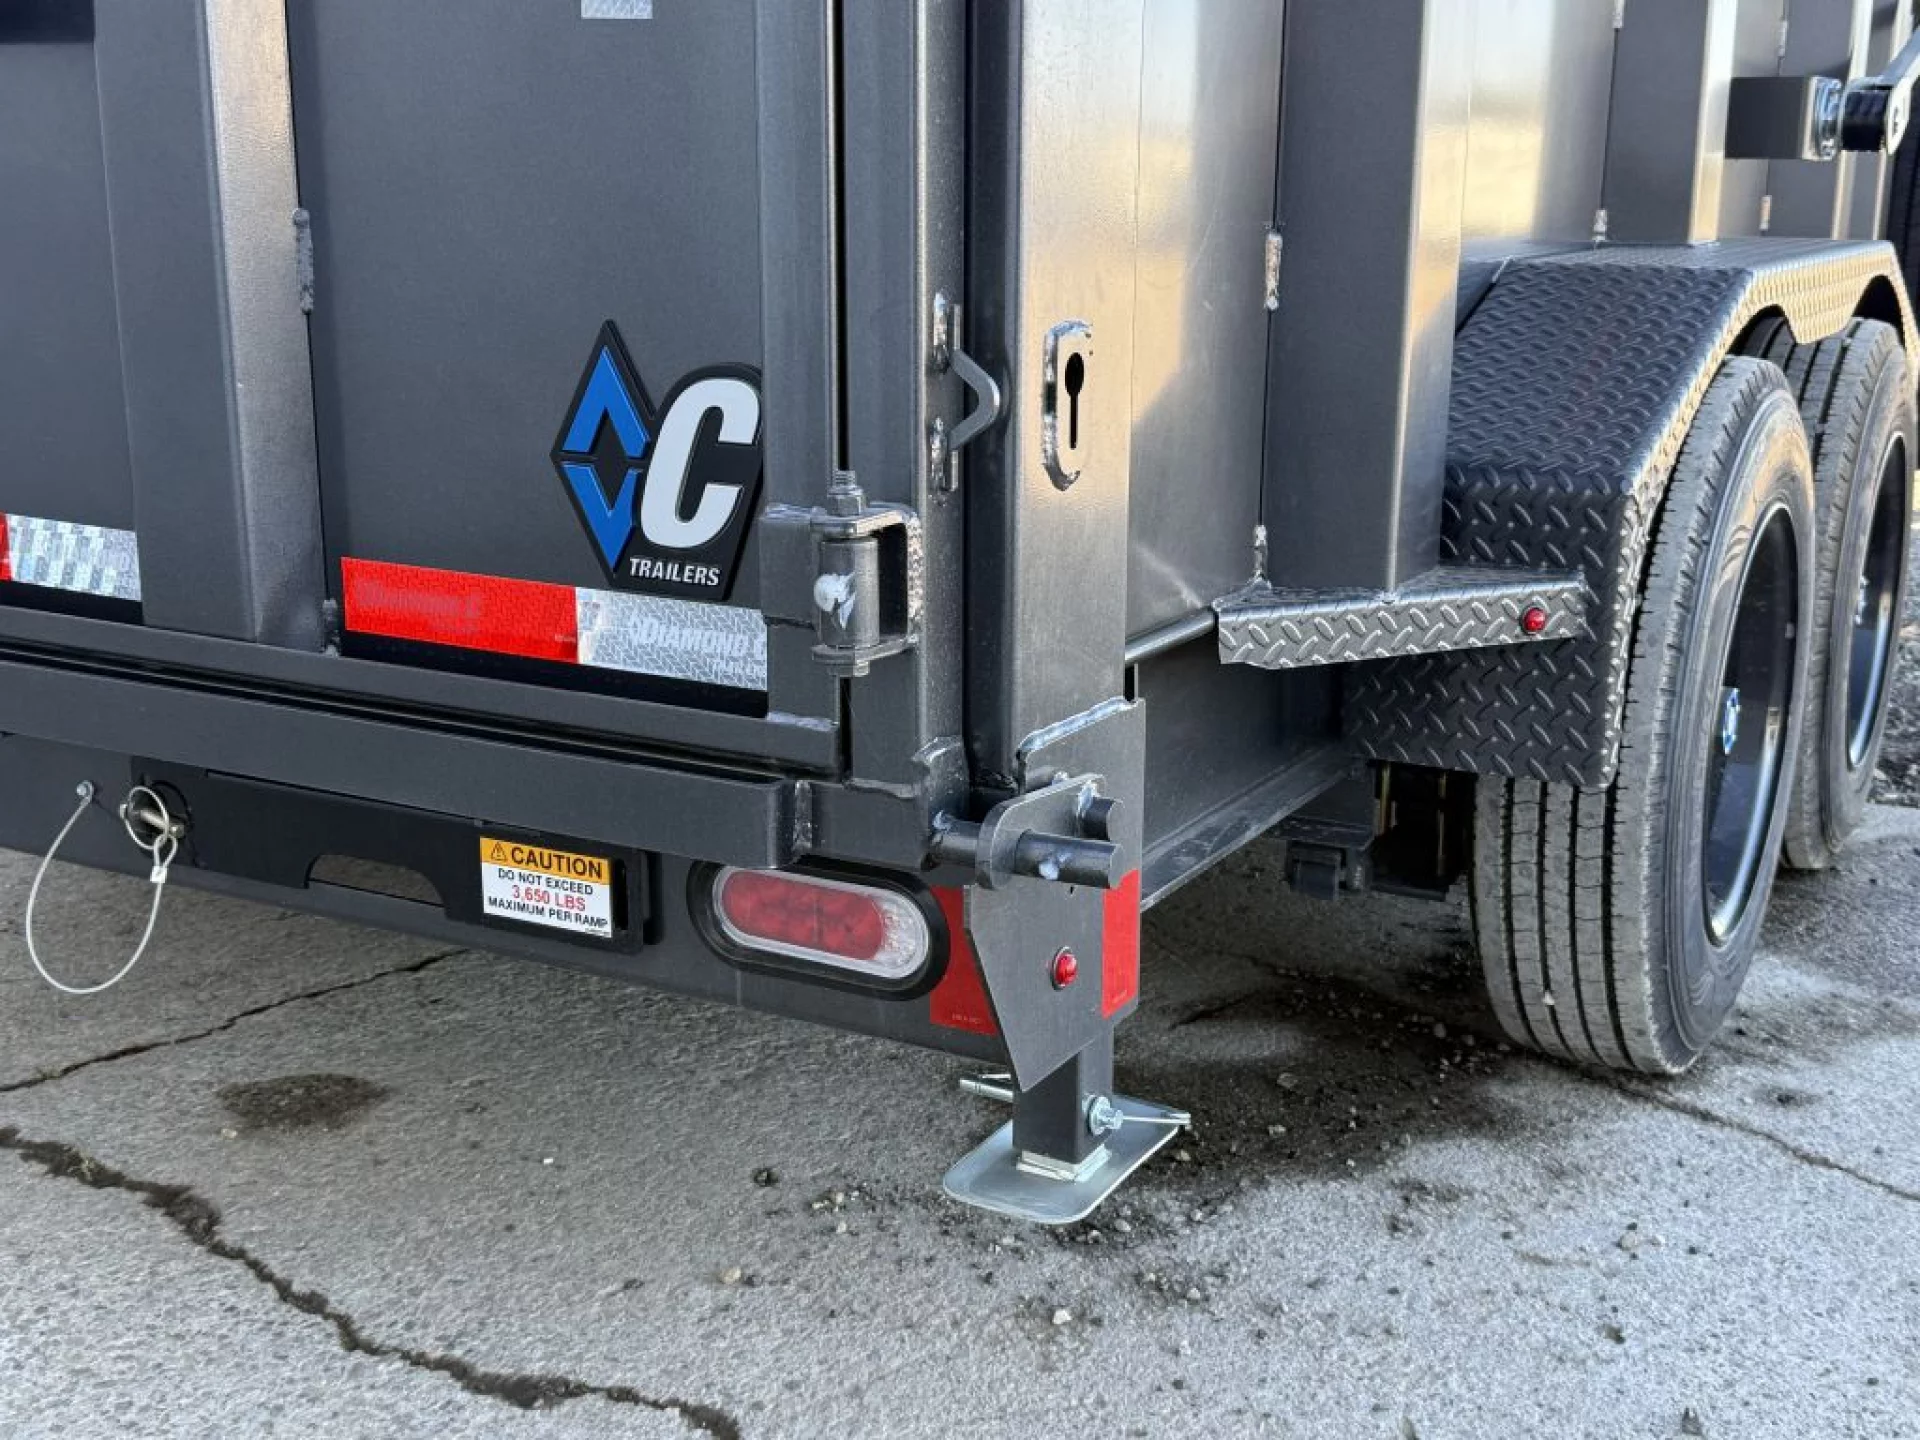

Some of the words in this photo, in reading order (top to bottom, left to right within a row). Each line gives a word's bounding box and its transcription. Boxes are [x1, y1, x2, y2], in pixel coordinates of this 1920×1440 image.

[640, 378, 760, 548] C
[629, 557, 721, 586] TRAILERS
[511, 846, 601, 879] CAUTION
[498, 867, 515, 880] DO
[519, 871, 543, 885] NOT
[545, 877, 593, 895] EXCEED
[488, 896, 545, 915] MAXIMUM
[549, 909, 572, 922] PER
[575, 913, 608, 927] RAMP
[555, 893, 586, 911] LBS
